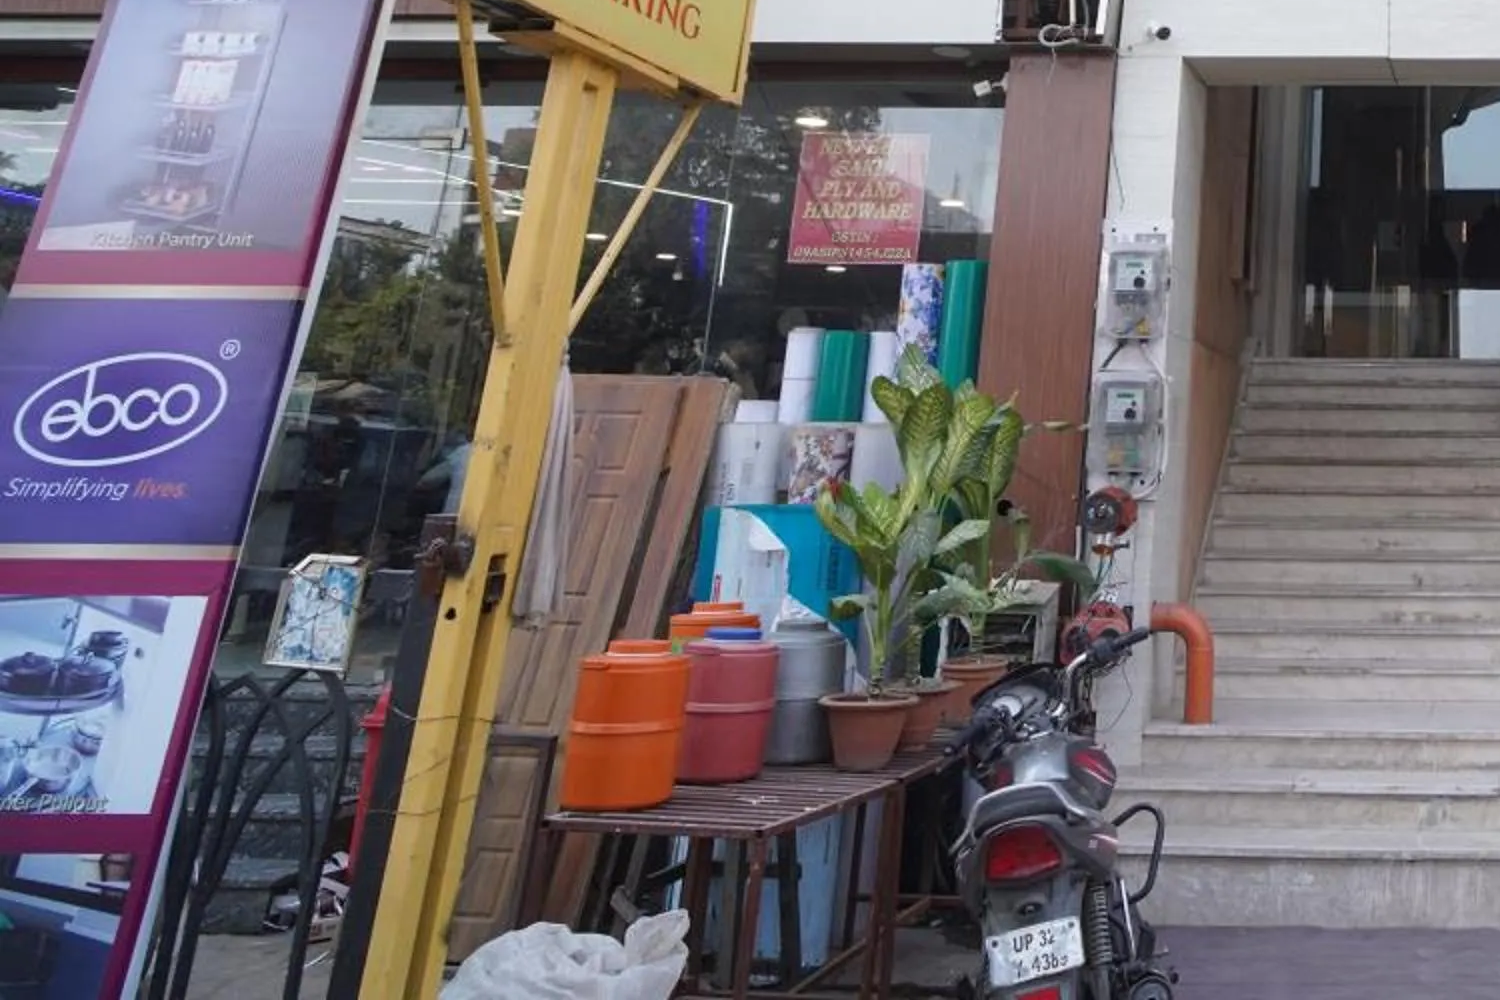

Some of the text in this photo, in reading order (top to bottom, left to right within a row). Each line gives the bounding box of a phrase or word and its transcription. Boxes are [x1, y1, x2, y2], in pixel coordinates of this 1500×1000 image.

[860, 180, 901, 199] AND
[802, 201, 914, 219] HARDWARE
[158, 232, 216, 251] Pantry
[219, 230, 255, 248] Unit
[41, 366, 201, 443] ebco
[3, 477, 188, 502] Simplifying lives
[1013, 932, 1034, 954] UP
